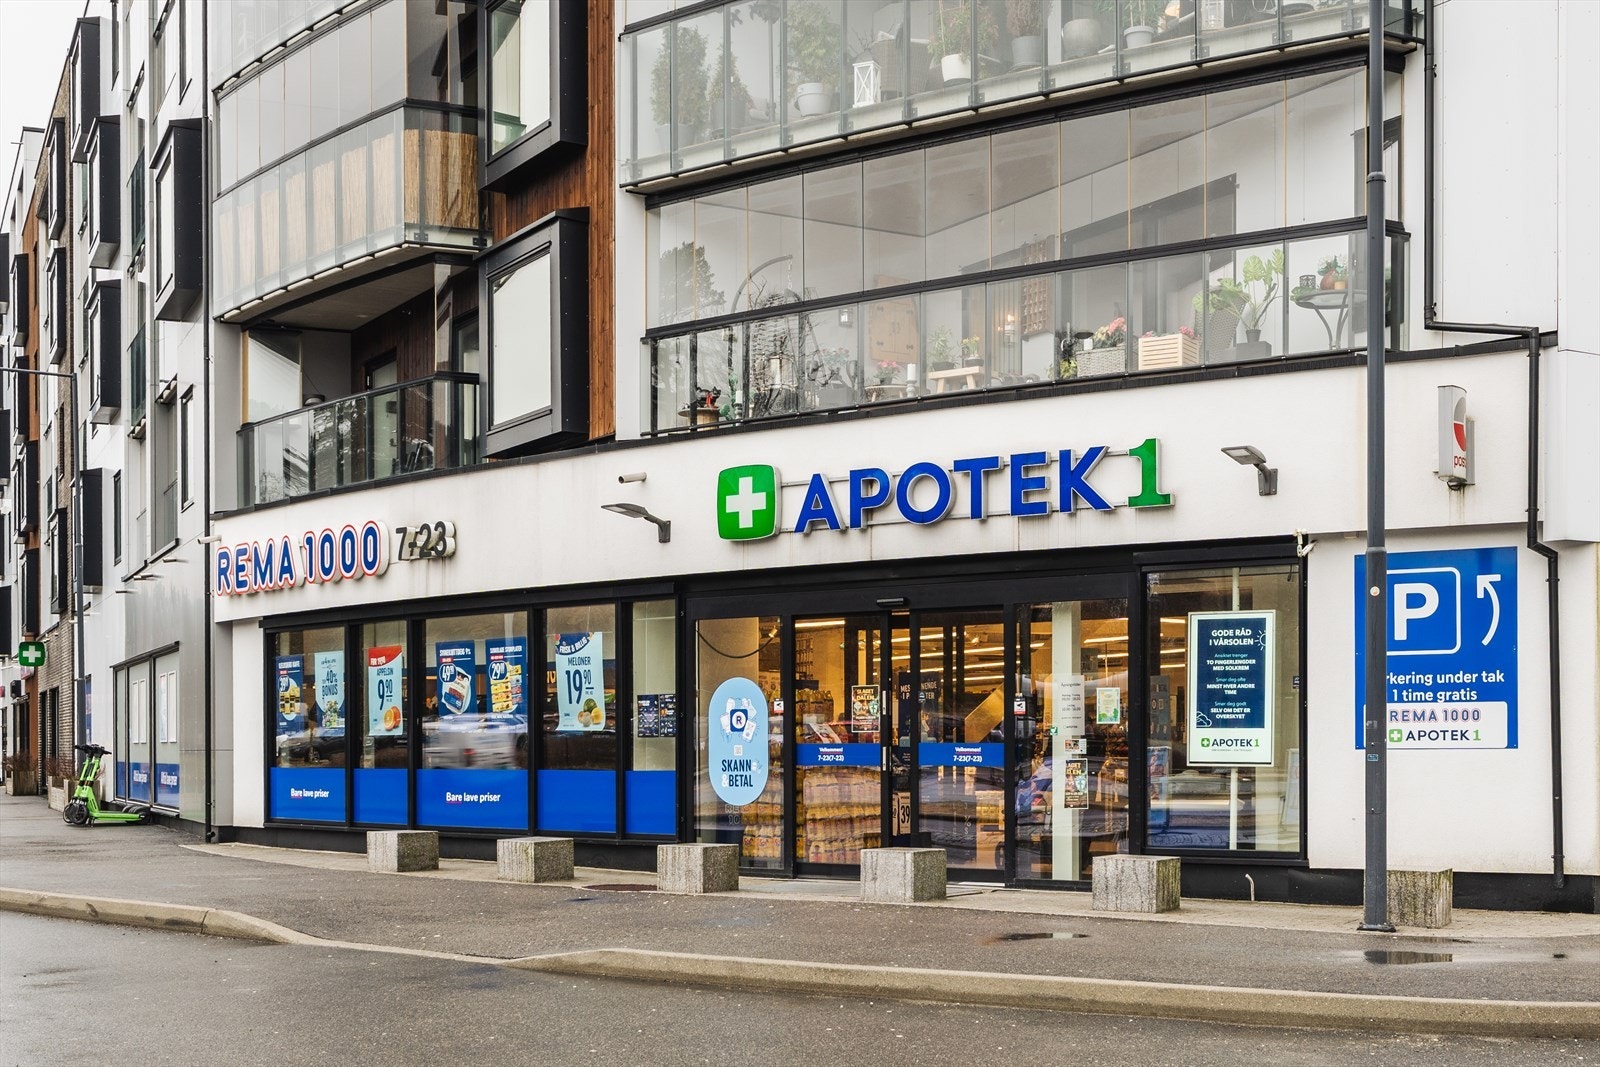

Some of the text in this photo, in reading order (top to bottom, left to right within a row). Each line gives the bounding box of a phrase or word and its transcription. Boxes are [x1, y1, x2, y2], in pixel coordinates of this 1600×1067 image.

[794, 438, 1175, 534] APOTEK 1
[396, 520, 450, 561] 7-23
[216, 520, 381, 597] REMA 1000
[1394, 582, 1440, 640] P
[1213, 638, 1254, 646] VÅRSOLEN
[568, 656, 592, 666] MELONER
[442, 664, 450, 682] 49
[492, 663, 500, 680] 29
[1386, 670, 1505, 686] kering under tak
[322, 684, 338, 697] BONUS
[566, 669, 582, 704] 19
[584, 670, 592, 684] 90
[378, 679, 385, 710] 9
[1392, 688, 1478, 703] 1 time gratis
[736, 716, 742, 725] R
[1389, 709, 1482, 722] REMA 1000
[1212, 738, 1260, 747] APOTEK 1
[1406, 730, 1482, 741] APOTEK 1
[722, 760, 752, 772] SKANN
[291, 788, 329, 800] Bare lave priser
[446, 792, 500, 803] Bare lave priser
[900, 805, 910, 824] 39
